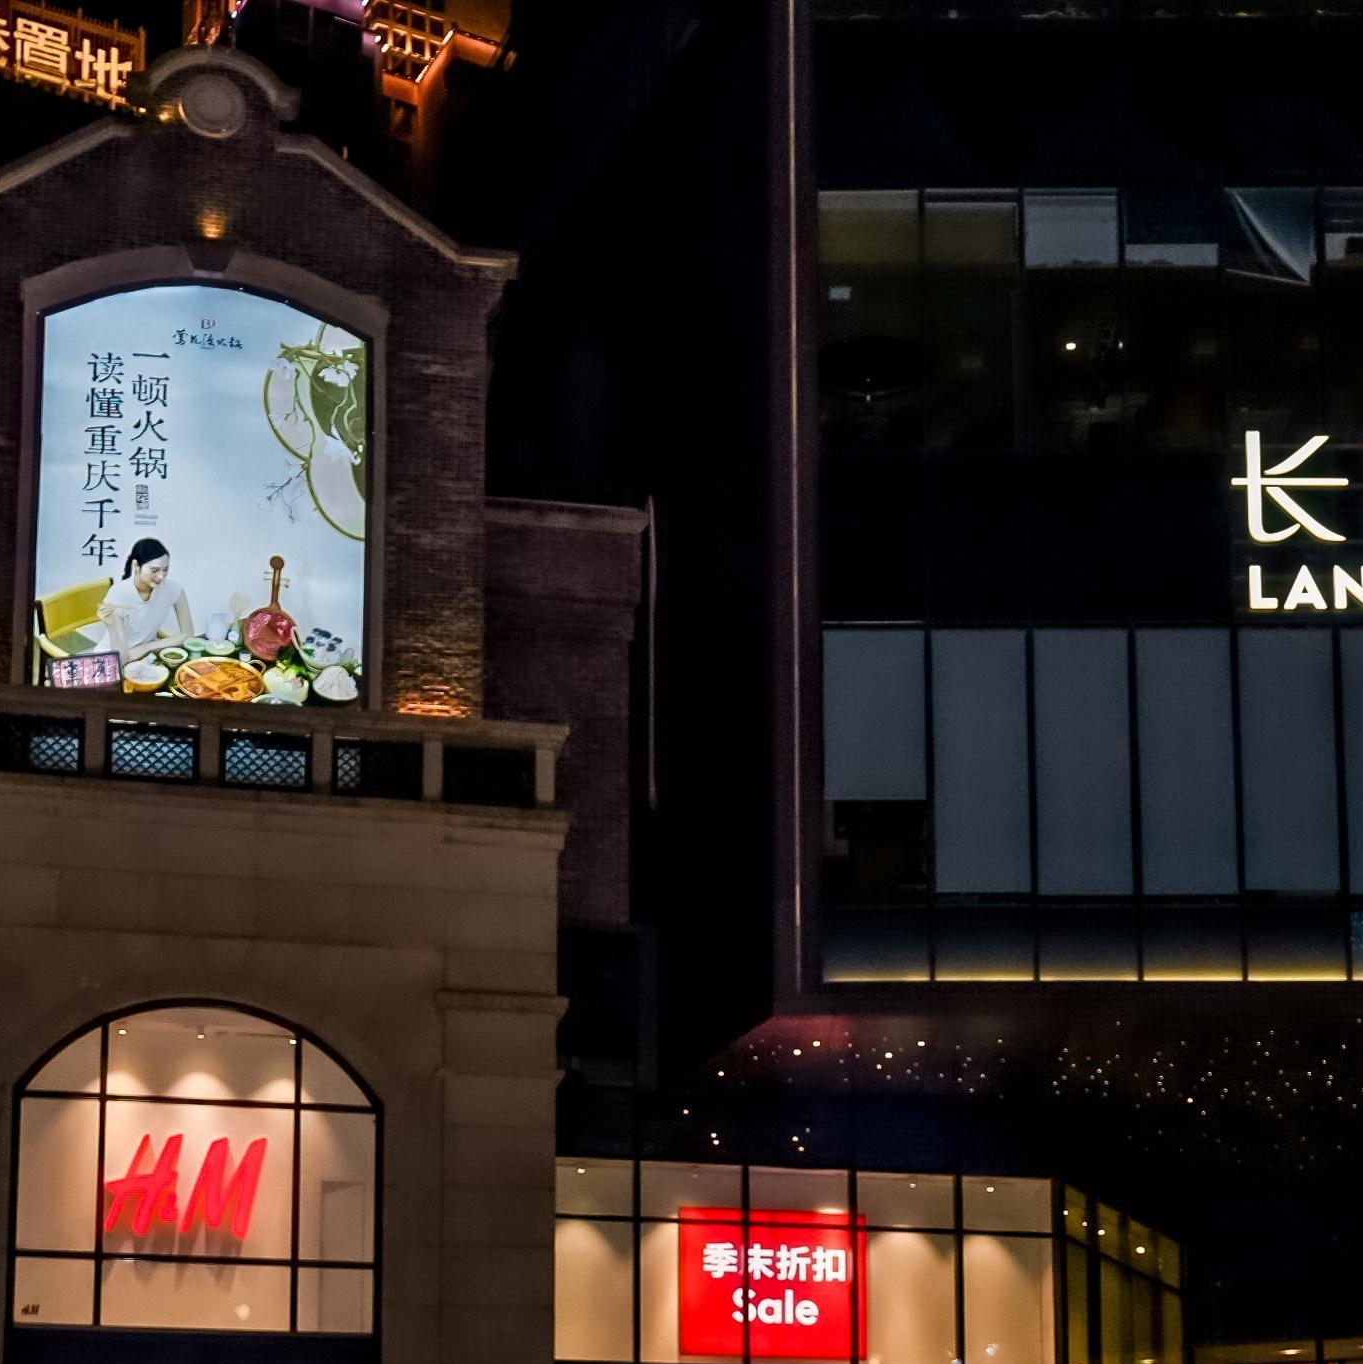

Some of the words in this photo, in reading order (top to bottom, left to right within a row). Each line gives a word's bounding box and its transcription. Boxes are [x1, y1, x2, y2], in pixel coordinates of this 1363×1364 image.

[82, 352, 125, 566] 读懂重庆千年
[127, 352, 171, 481] 一顿火锅
[103, 1133, 268, 1240] H&M
[702, 1242, 847, 1282] 季末折扣
[732, 1288, 820, 1325] Sale
